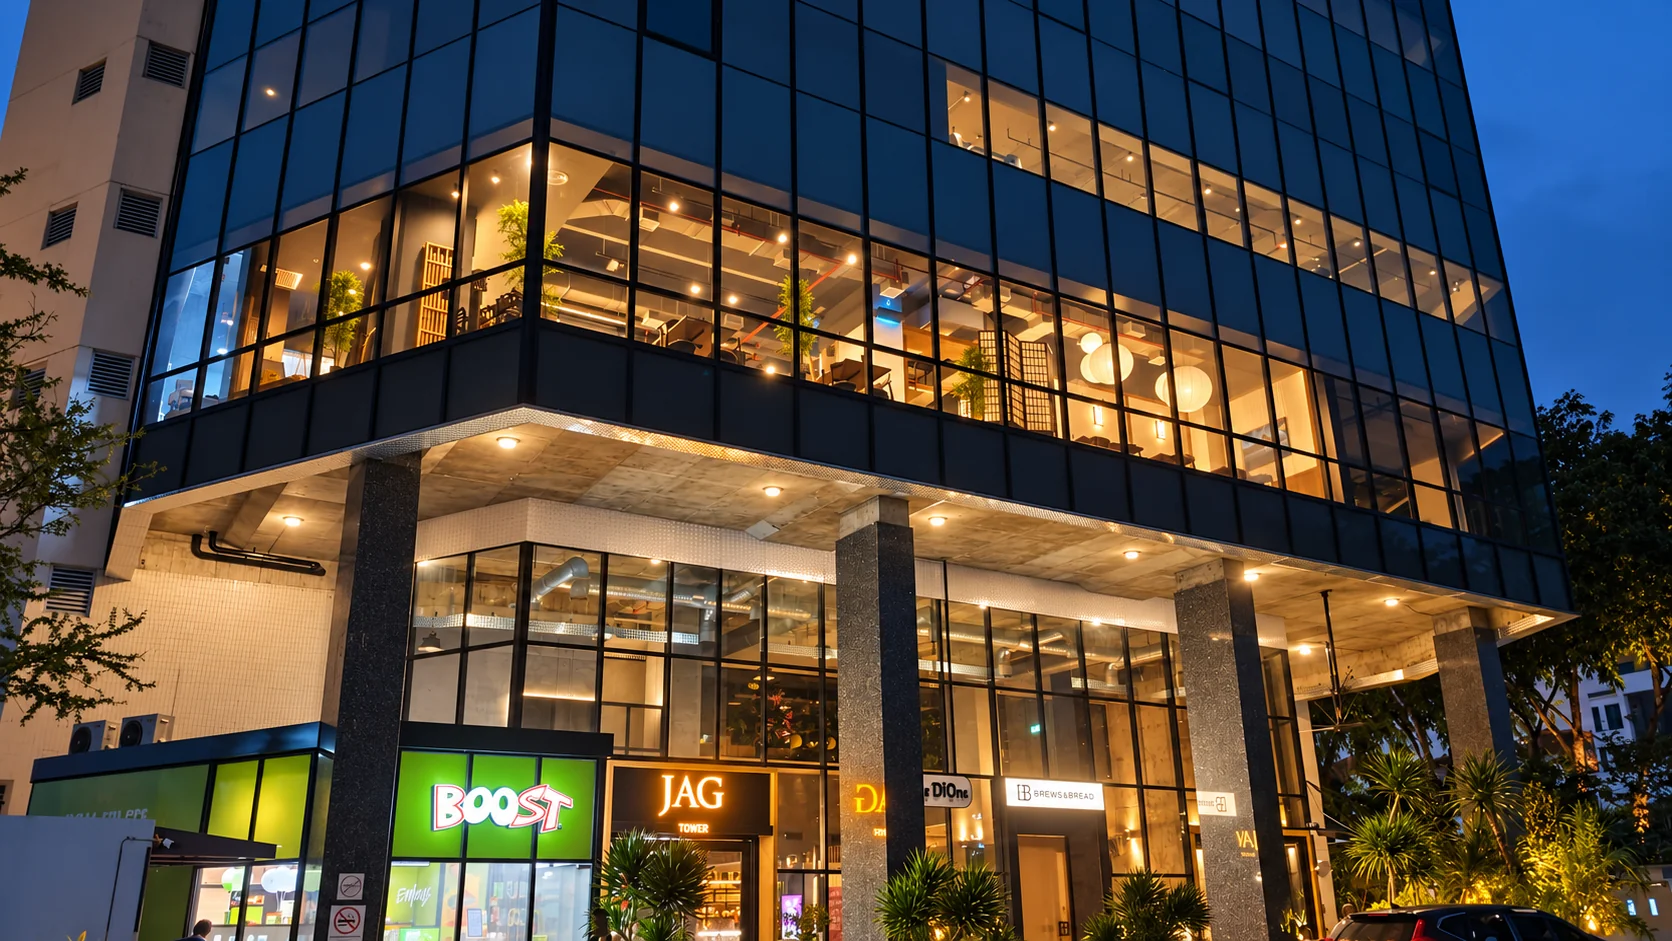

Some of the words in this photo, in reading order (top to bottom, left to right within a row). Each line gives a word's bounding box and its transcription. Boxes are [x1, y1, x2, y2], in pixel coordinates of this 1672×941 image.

[433, 783, 573, 833] BOOST
[658, 775, 725, 817] JAG
[678, 823, 709, 833] TOWER
